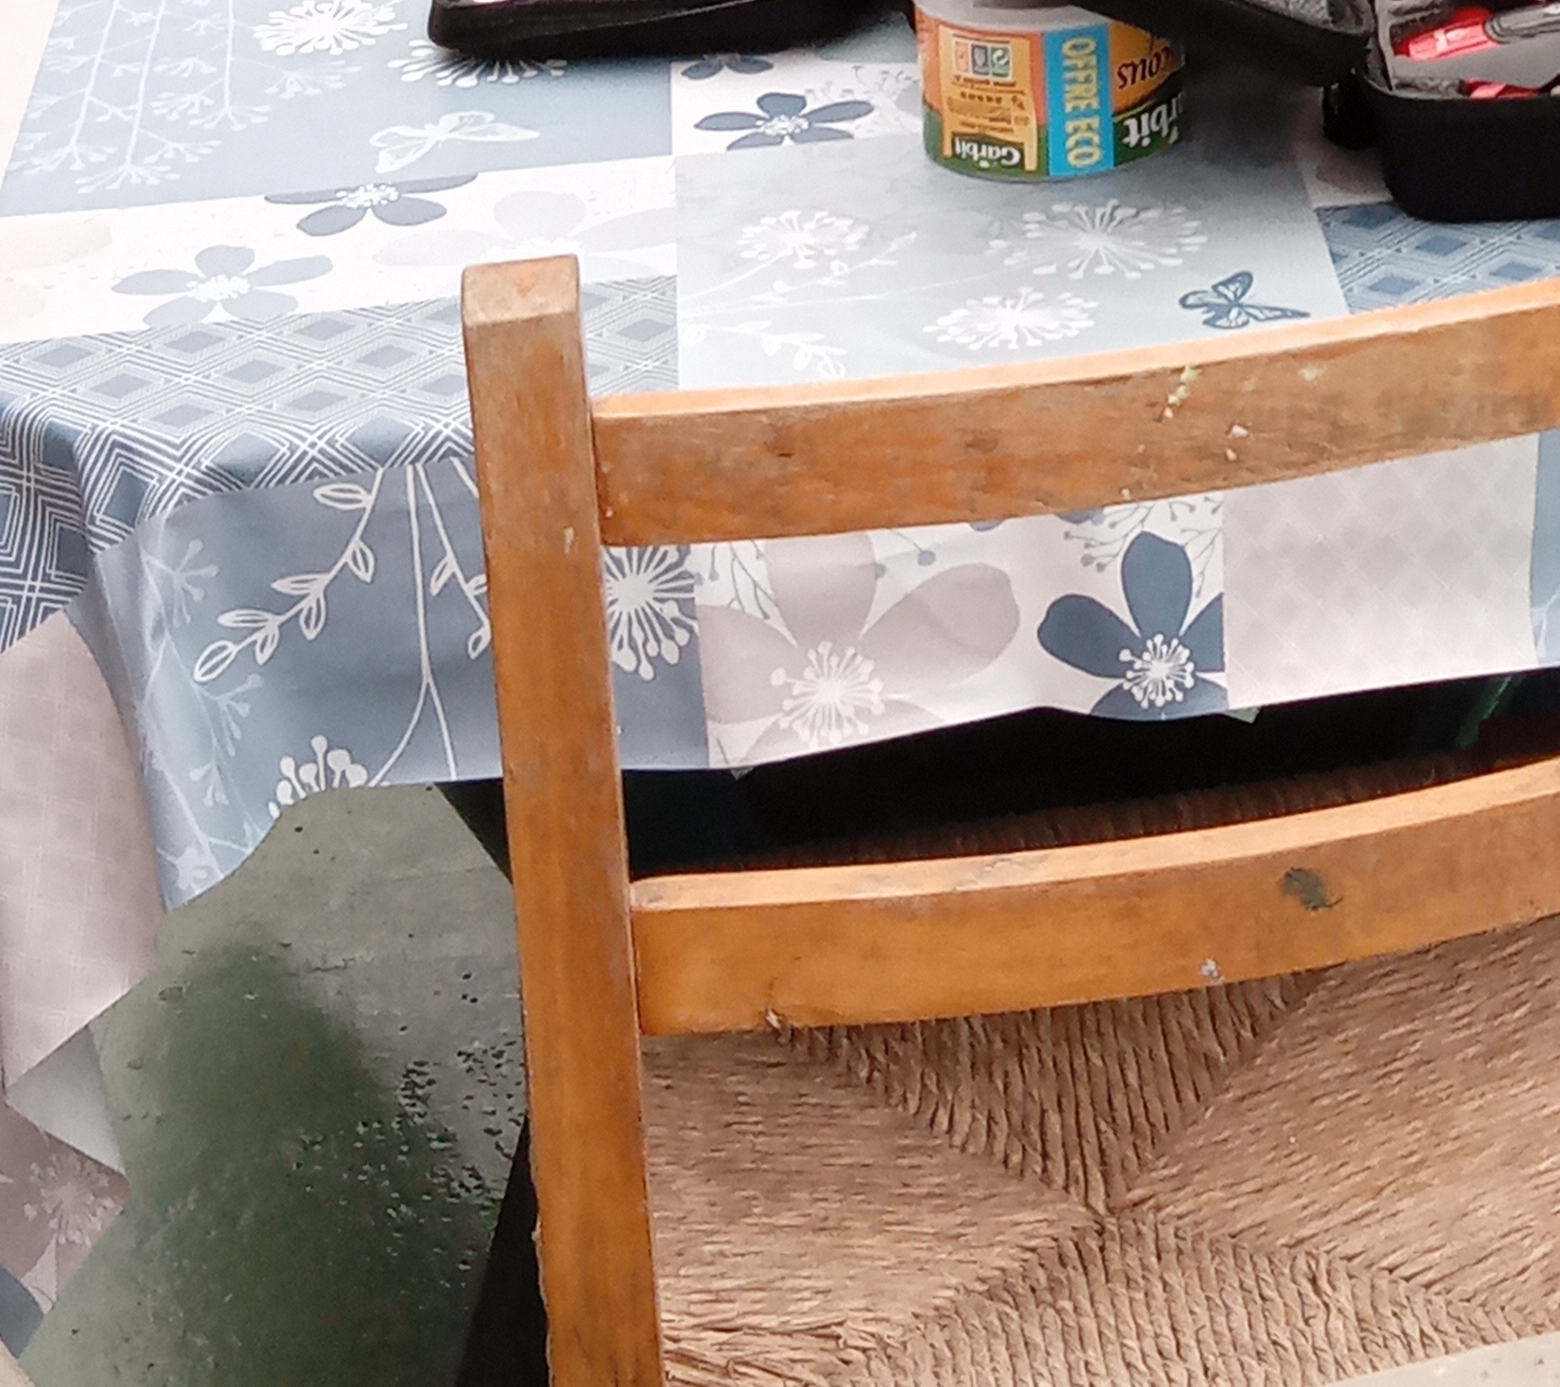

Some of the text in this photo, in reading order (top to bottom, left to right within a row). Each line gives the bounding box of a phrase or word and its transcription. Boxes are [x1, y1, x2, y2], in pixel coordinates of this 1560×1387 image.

[1061, 37, 1101, 169] OFFRE ECO
[954, 137, 1021, 168] Garbit
